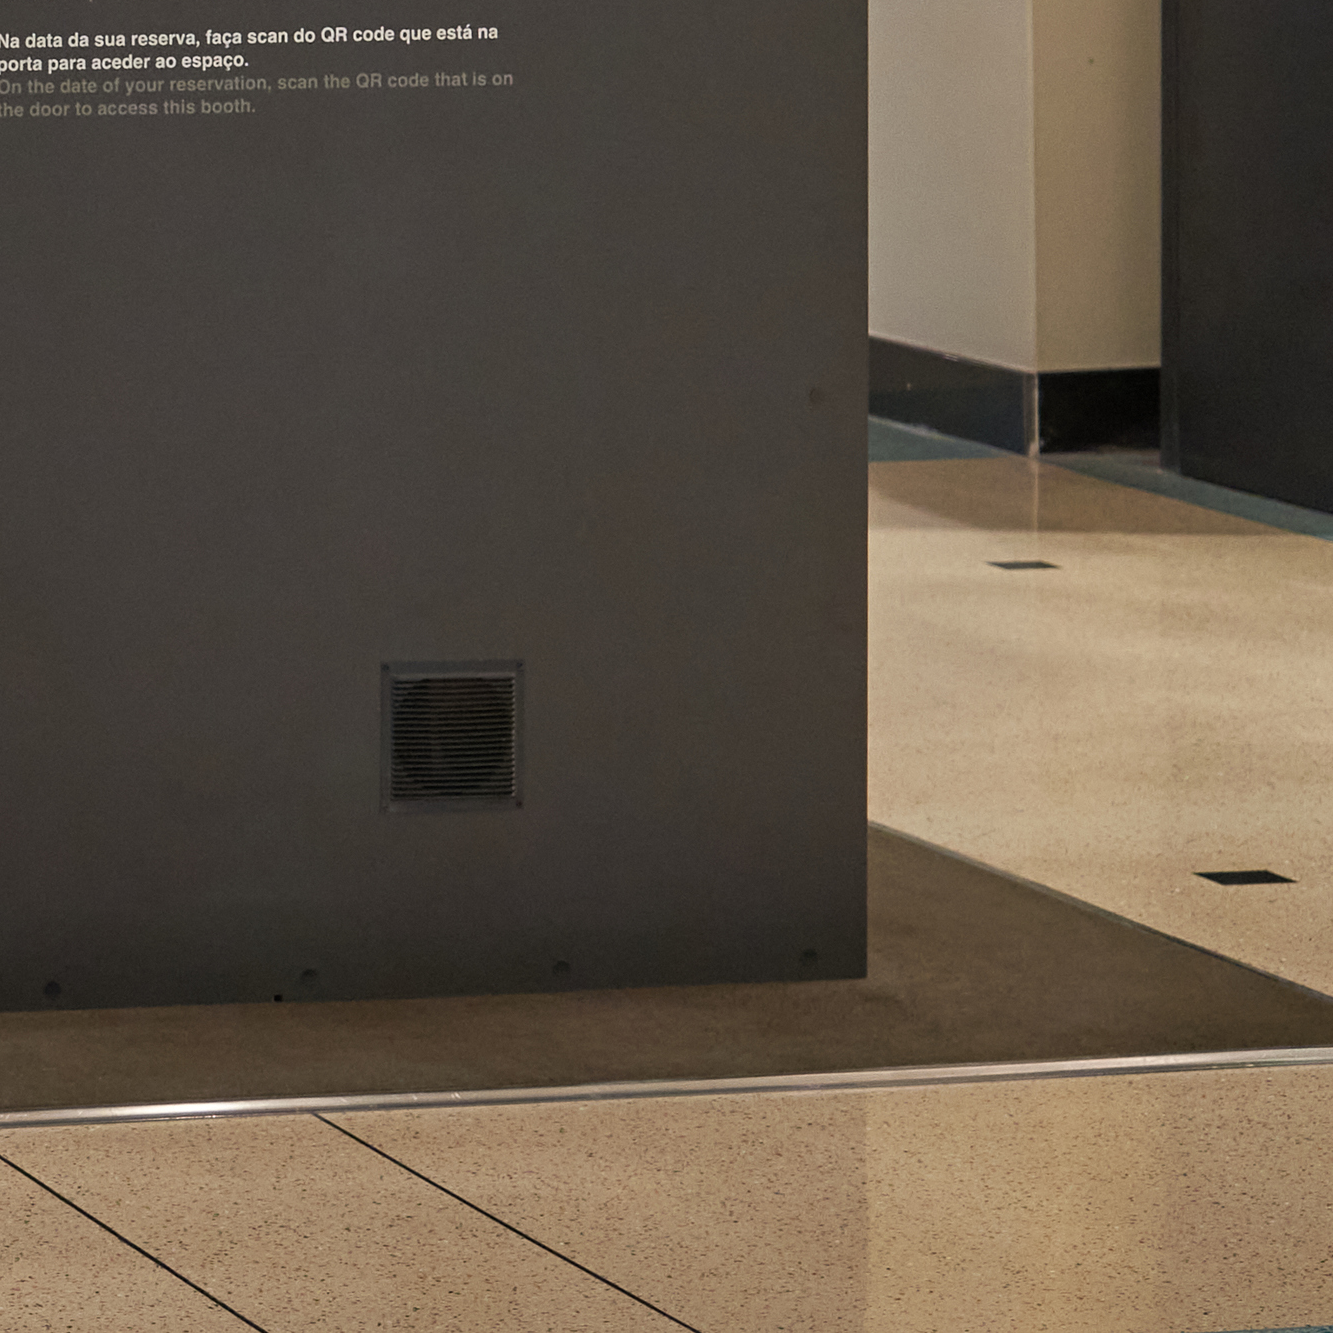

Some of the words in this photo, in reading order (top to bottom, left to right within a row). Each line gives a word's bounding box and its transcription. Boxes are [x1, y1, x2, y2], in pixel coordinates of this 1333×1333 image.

[25, 33, 62, 48] data
[68, 32, 89, 47] da
[95, 35, 125, 47] sua
[132, 34, 200, 47] reserva,
[206, 30, 241, 48] faça
[248, 31, 288, 44] scan
[294, 28, 315, 42] do
[321, 27, 347, 42] QR
[353, 26, 394, 41] code
[400, 29, 431, 44] que
[437, 24, 472, 40] está
[478, 28, 498, 39] na
[48, 58, 86, 74] para
[92, 54, 150, 69] aceder
[156, 57, 176, 68] ao
[182, 55, 248, 71] espaço.
[28, 79, 55, 93] the
[60, 79, 97, 93] date
[103, 77, 119, 93] of
[125, 80, 164, 96] your
[170, 76, 271, 92] reservation,
[278, 78, 317, 89] scan
[324, 74, 350, 89] the
[356, 73, 382, 88] QR
[388, 73, 429, 87] code
[435, 72, 467, 86] that
[473, 72, 486, 86] is
[492, 74, 513, 85] on
[30, 102, 70, 116] door
[75, 102, 92, 115] to
[98, 103, 158, 115] access
[163, 99, 195, 114] this
[201, 99, 255, 113] booth.
